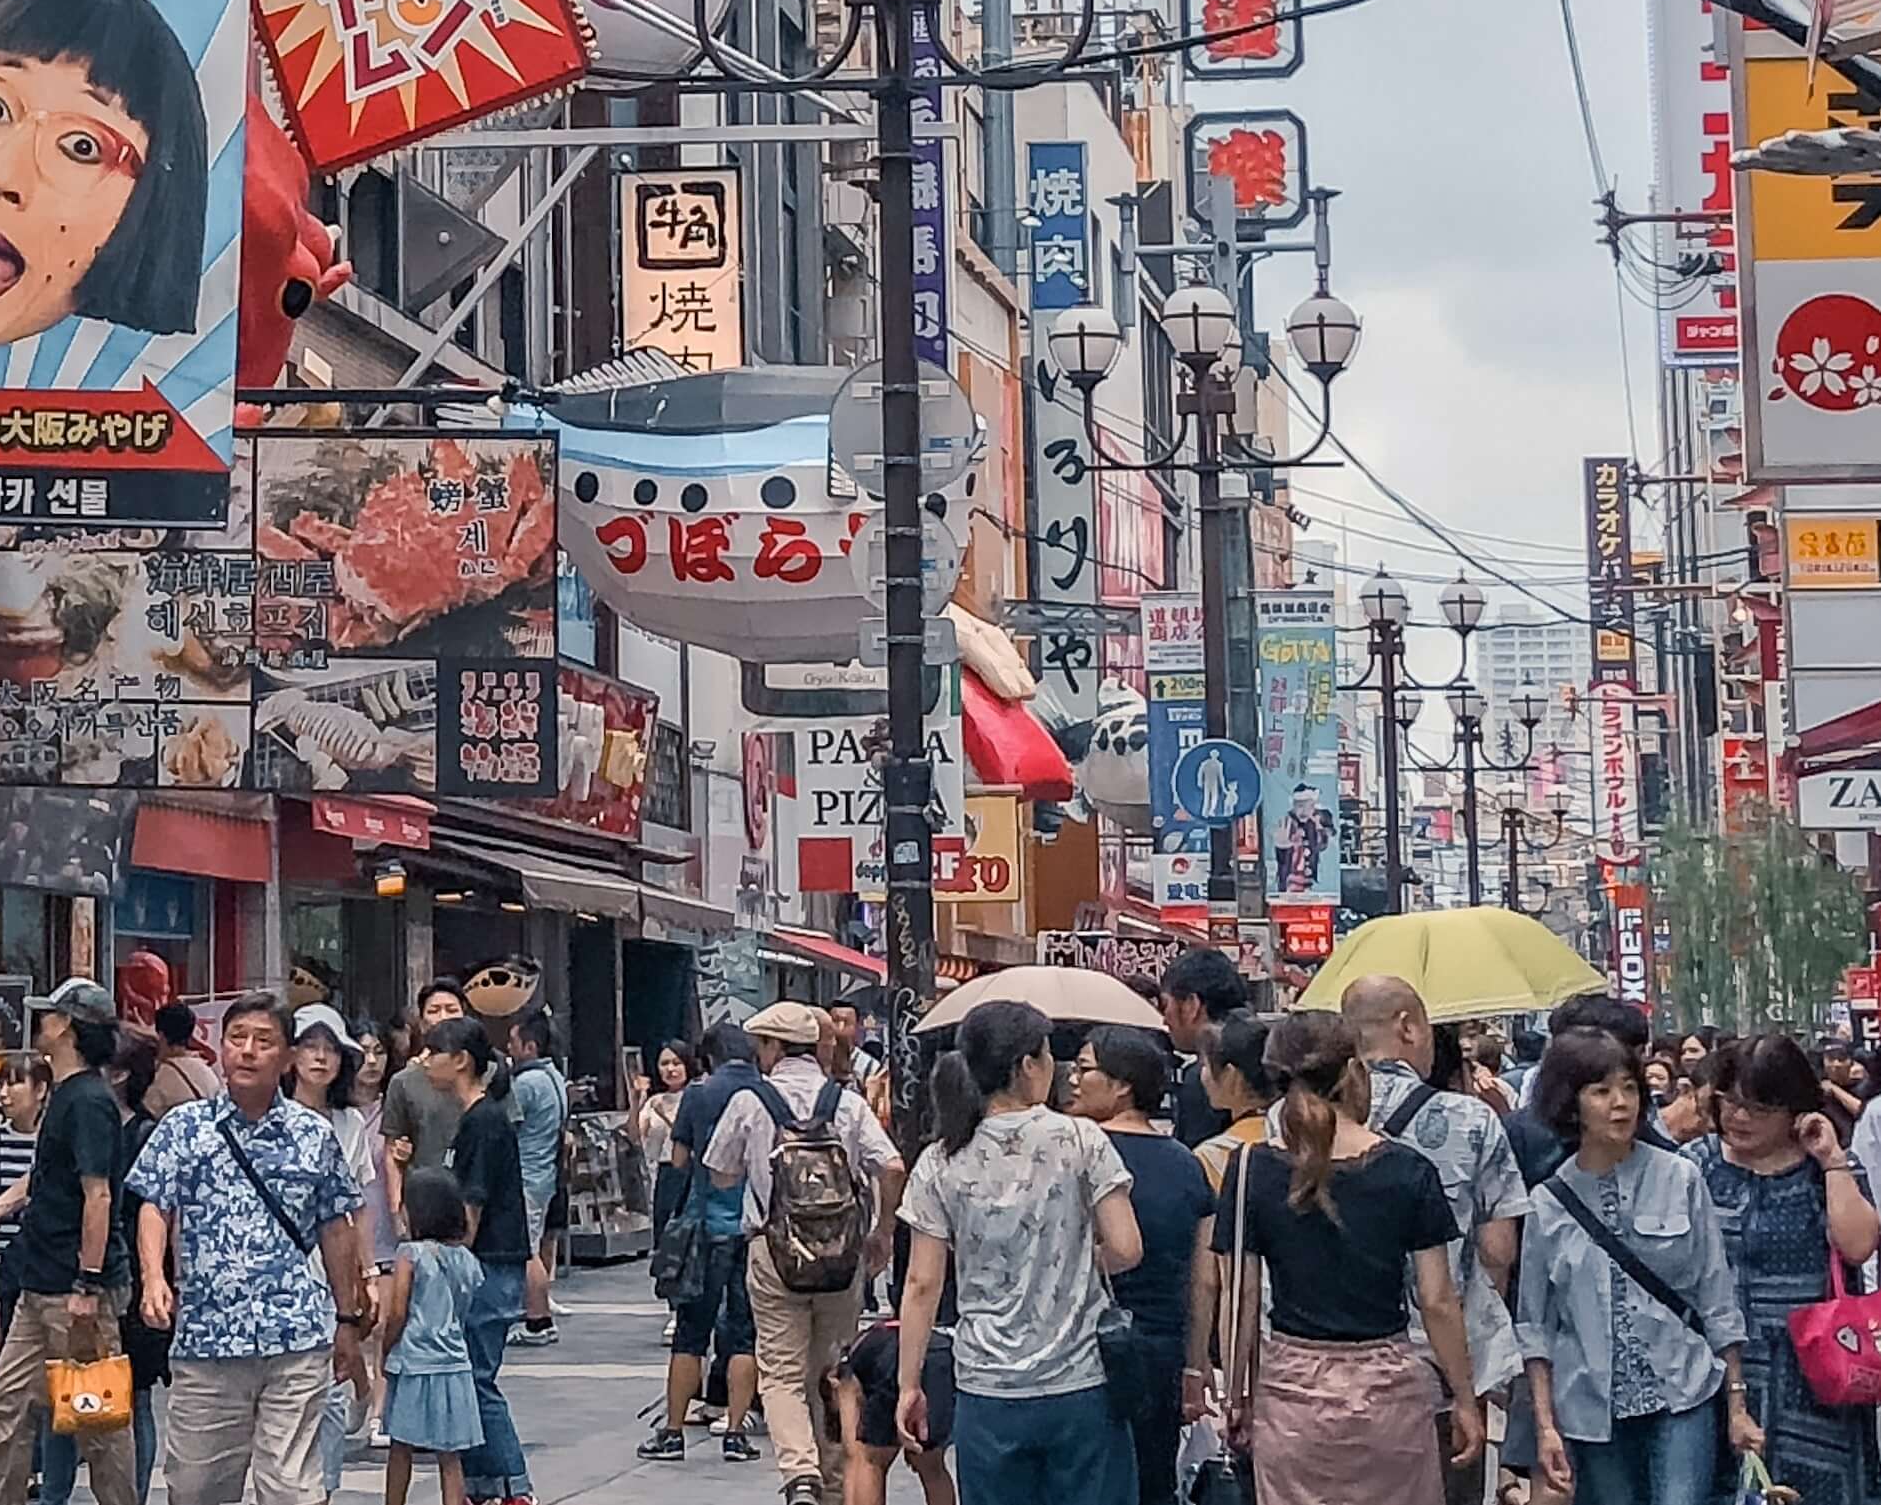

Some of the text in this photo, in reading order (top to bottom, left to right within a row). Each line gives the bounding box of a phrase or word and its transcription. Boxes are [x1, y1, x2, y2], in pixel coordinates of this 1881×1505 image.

[649, 196, 717, 251] 牛角
[1030, 169, 1087, 283] 焼肉
[46, 473, 111, 516] 선물
[1595, 463, 1622, 557] カラオケ
[596, 510, 871, 582] づぼら
[807, 729, 954, 765] PAA
